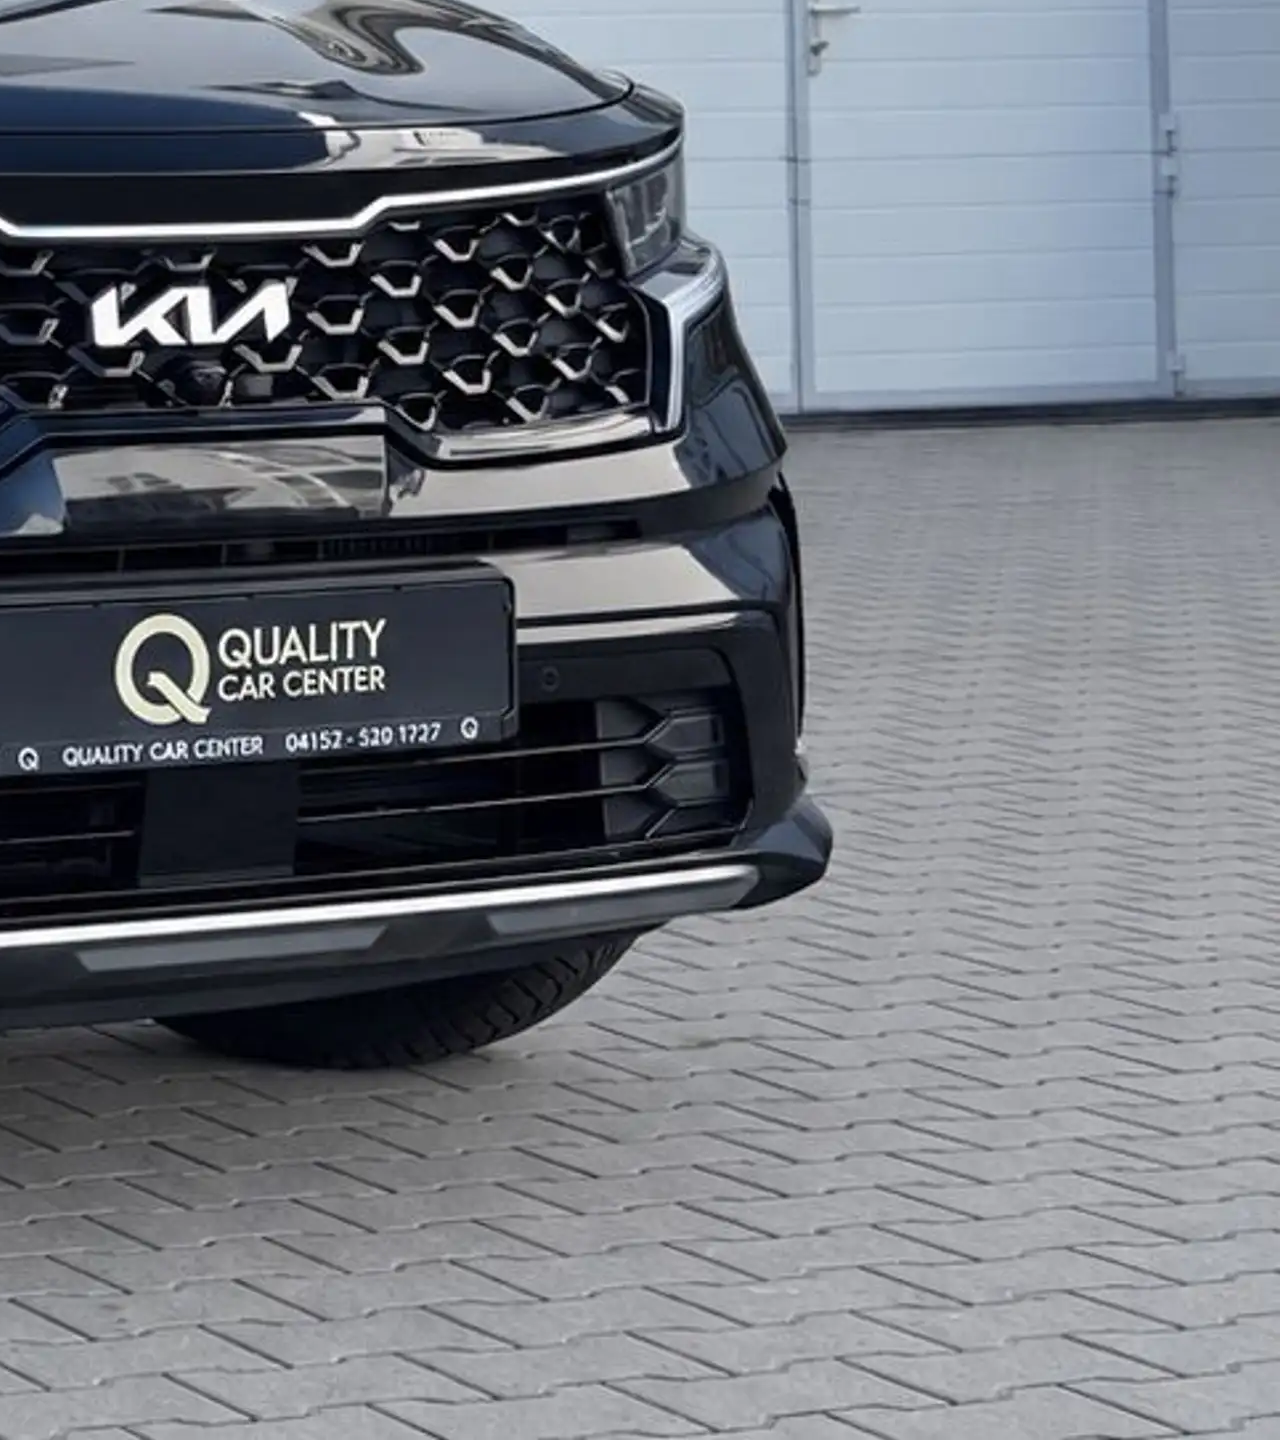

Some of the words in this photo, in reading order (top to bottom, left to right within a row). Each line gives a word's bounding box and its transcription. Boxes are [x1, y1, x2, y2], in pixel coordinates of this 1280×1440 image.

[91, 283, 290, 347] KIA
[115, 613, 211, 725] Q
[217, 618, 386, 669] QUALITY
[217, 674, 276, 702] CAR
[282, 665, 385, 697] CENTER
[62, 743, 143, 767] QUALITY
[149, 740, 188, 763] CAR
[193, 735, 263, 759] CENTER
[285, 729, 343, 753] 04152
[359, 726, 393, 747] 520
[398, 721, 441, 743] 1727
